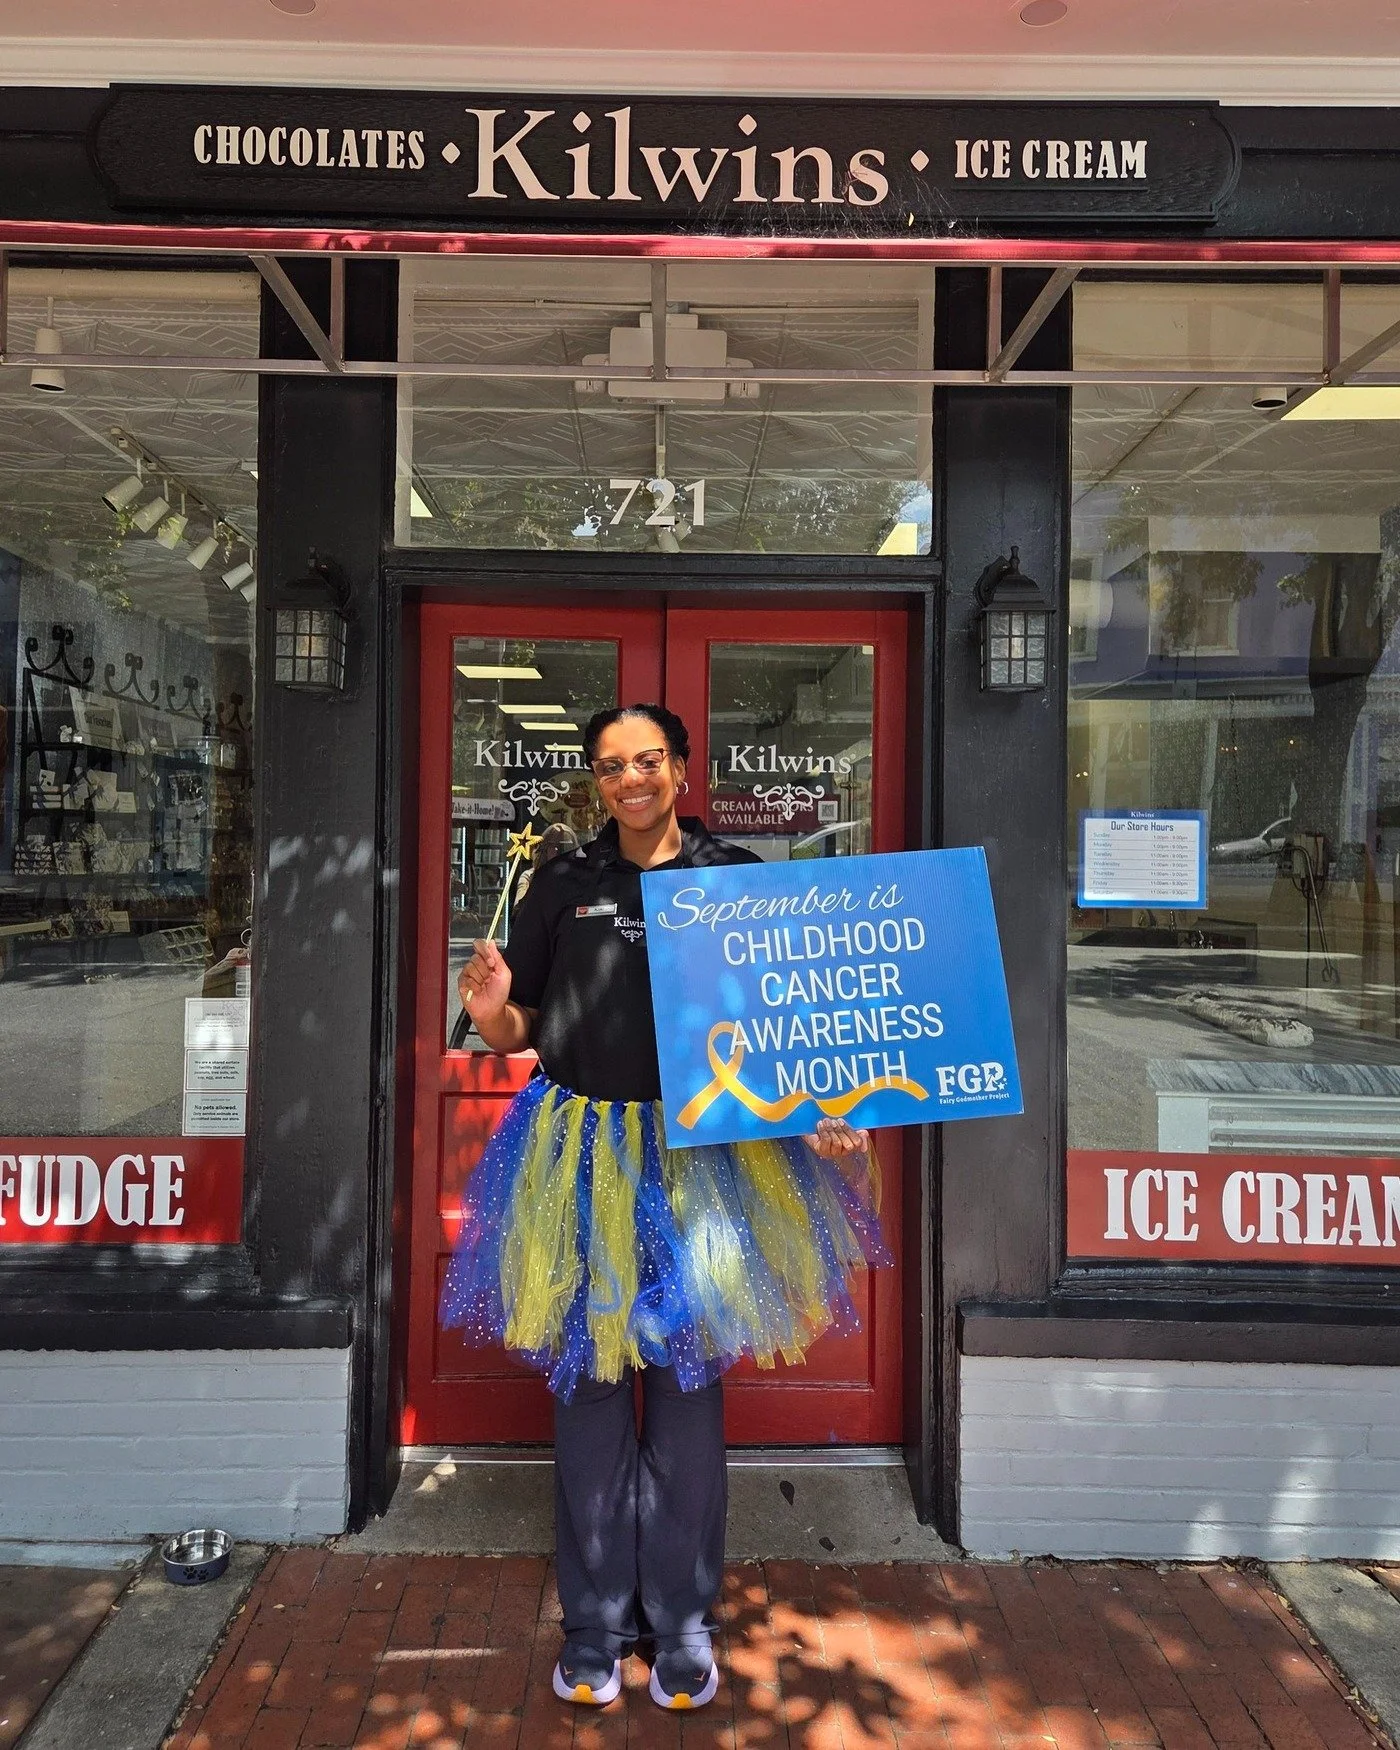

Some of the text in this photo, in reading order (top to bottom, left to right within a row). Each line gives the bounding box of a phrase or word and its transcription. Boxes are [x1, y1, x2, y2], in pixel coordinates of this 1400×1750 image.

[193, 106, 1148, 207] CHOCOLATES Kilwins ICE CREAM
[609, 478, 706, 526] 721
[473, 739, 594, 770] Kilwin
[728, 744, 853, 774] Kilwins
[712, 800, 756, 812] CREAM
[718, 814, 784, 825] AVAILABLE
[1110, 821, 1174, 832] Our Store Hours
[613, 916, 646, 928] Kilwin
[657, 883, 904, 932] September is
[722, 917, 925, 966] CHILDHOOD
[760, 962, 904, 1007] CANCER
[729, 1002, 944, 1056] AWARENESS
[775, 1049, 908, 1098] MONTH
[955, 1094, 989, 1103] Godmother
[989, 1092, 1010, 1100] Project
[1103, 1168, 1199, 1242] ICE
